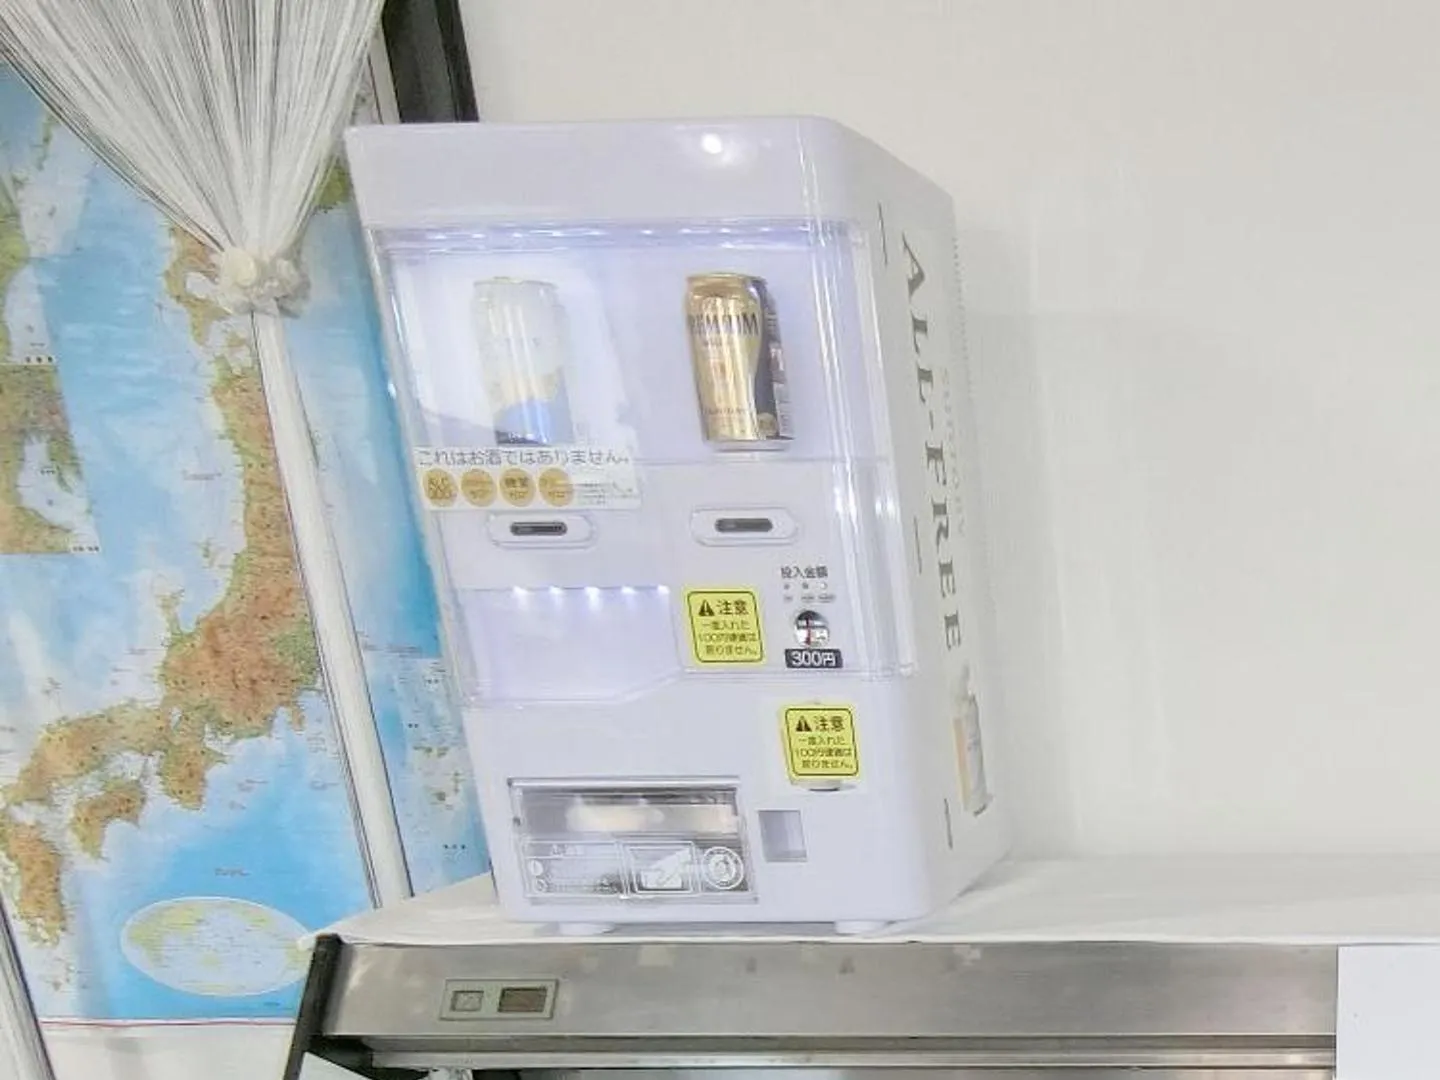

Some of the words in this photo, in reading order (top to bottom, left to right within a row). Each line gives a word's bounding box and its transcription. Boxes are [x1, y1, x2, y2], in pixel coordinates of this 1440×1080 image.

[902, 231, 961, 652] ALL-FREE
[715, 599, 750, 615] 注意
[791, 651, 835, 668] 300円
[813, 715, 845, 732] 注意
